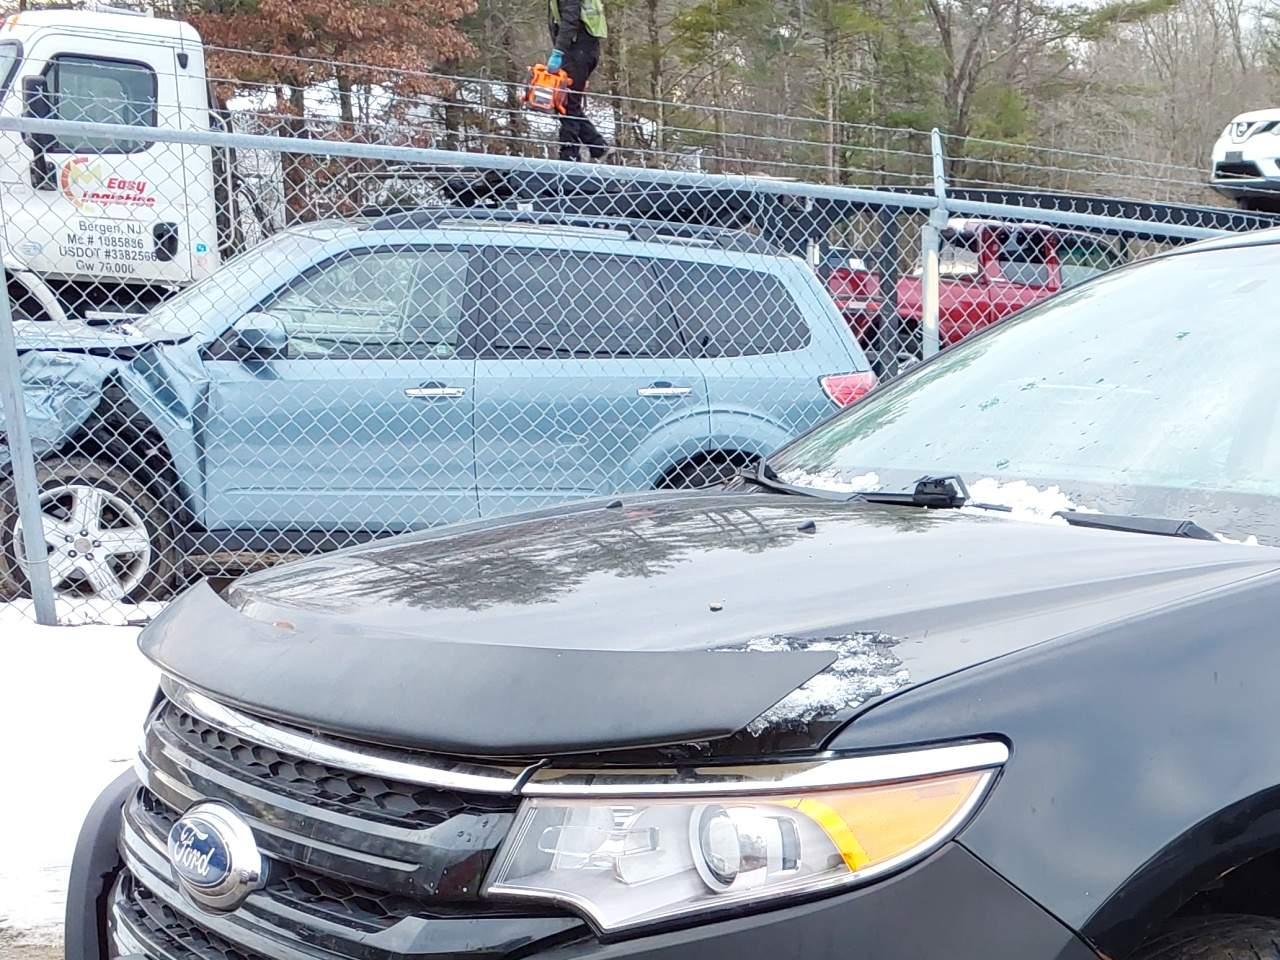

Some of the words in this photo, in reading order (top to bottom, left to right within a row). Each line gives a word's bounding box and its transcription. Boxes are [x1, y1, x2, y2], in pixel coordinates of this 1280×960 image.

[107, 178, 146, 194] Easy
[79, 220, 124, 235] Bergen,
[127, 223, 142, 235] NJ
[87, 235, 94, 246] #
[59, 246, 101, 258] USDOT
[174, 820, 215, 877] Ford
